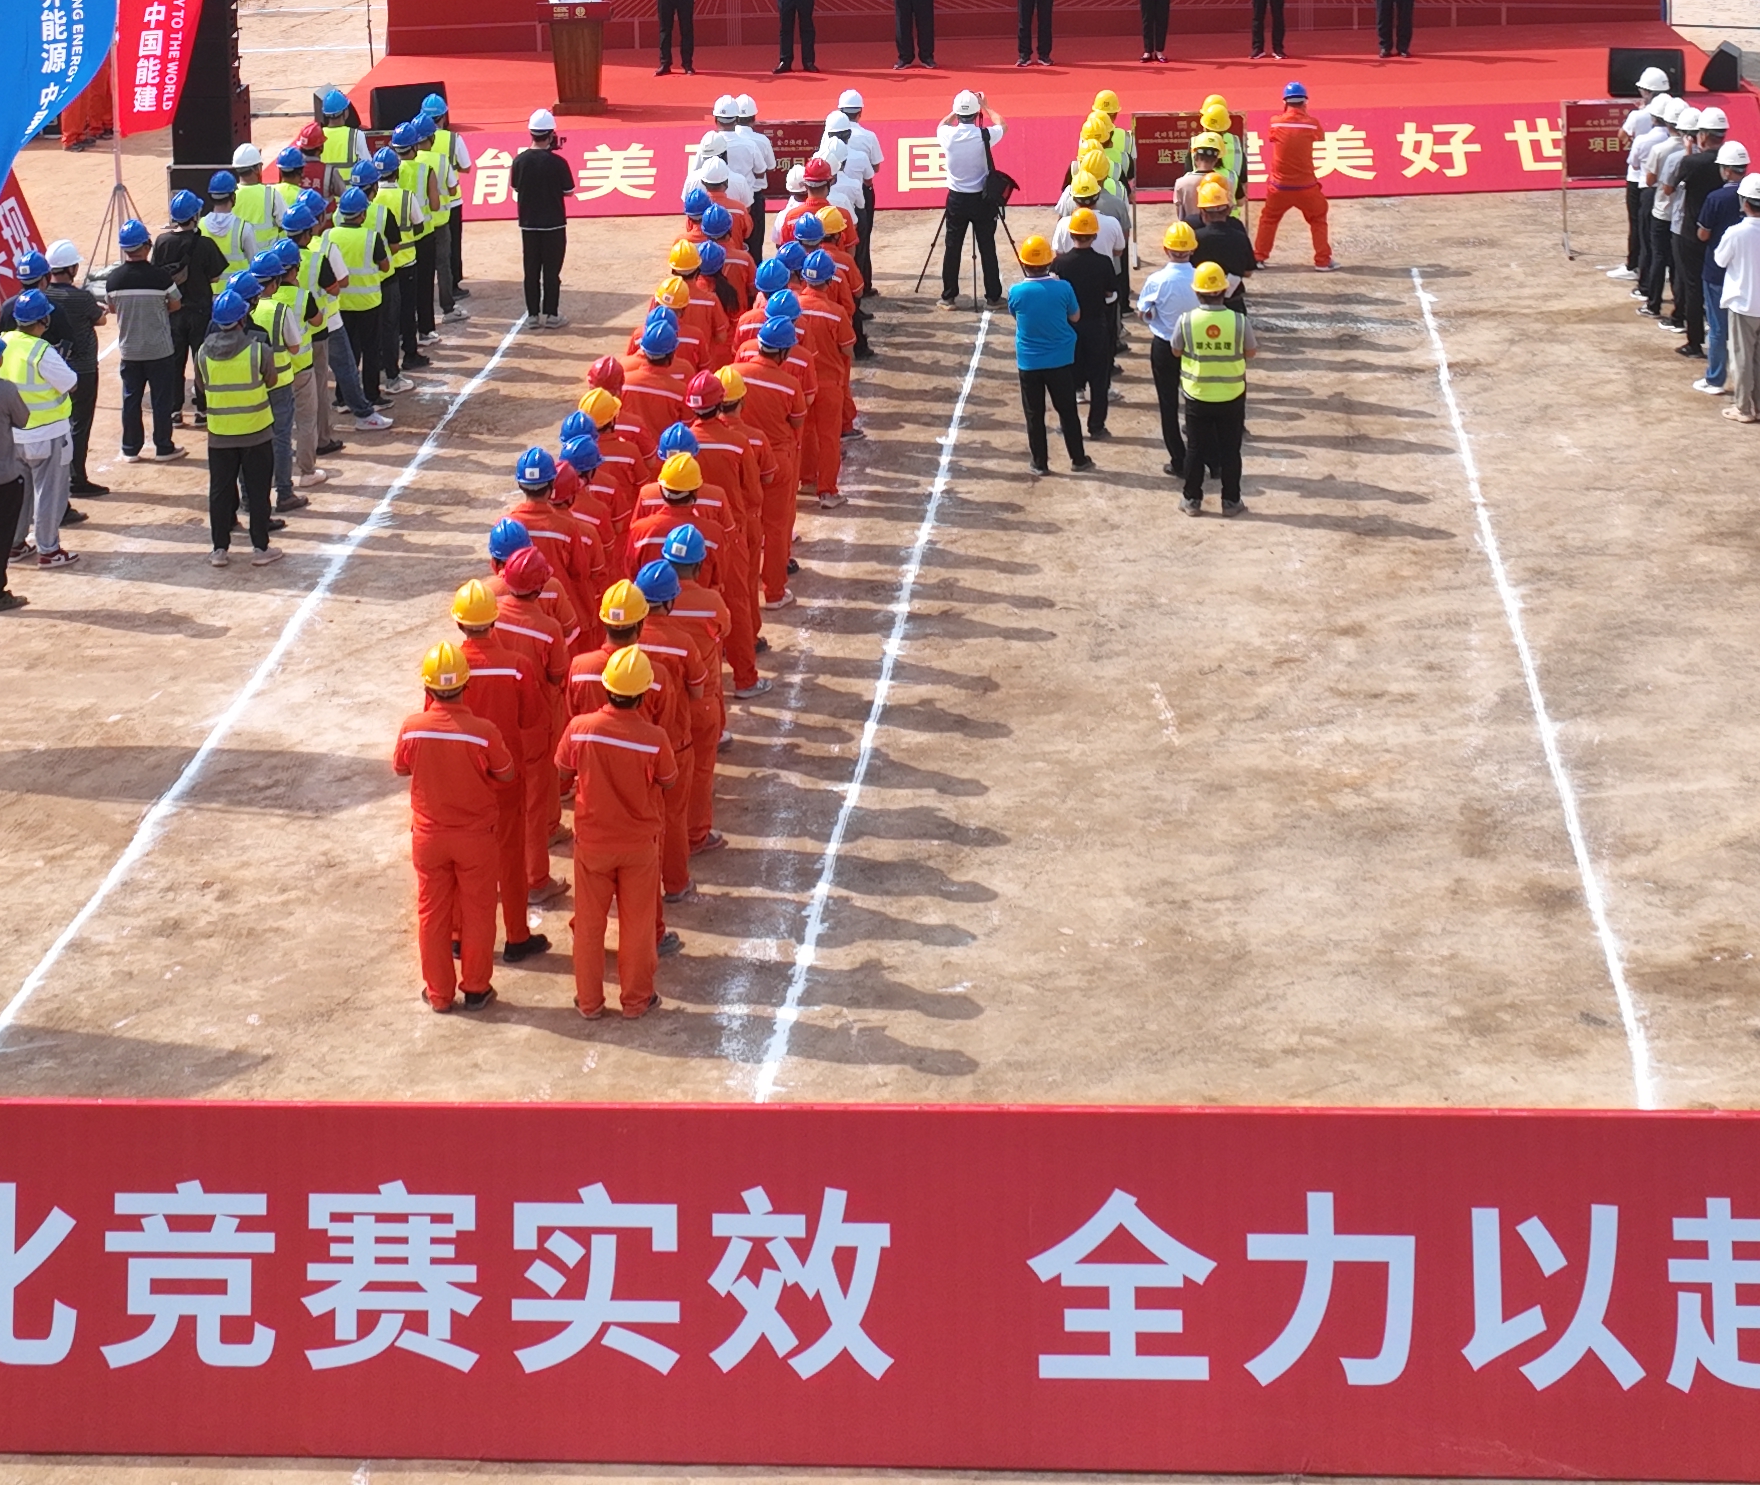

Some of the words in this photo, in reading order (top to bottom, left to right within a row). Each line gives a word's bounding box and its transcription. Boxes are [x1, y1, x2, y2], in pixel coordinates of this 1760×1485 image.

[170, 9, 184, 29] TO
[66, 23, 84, 84] ENERGY
[133, 1, 166, 113] 中国能建
[167, 31, 182, 59] THE
[162, 59, 179, 111] WORLD
[298, 177, 321, 188] 全员
